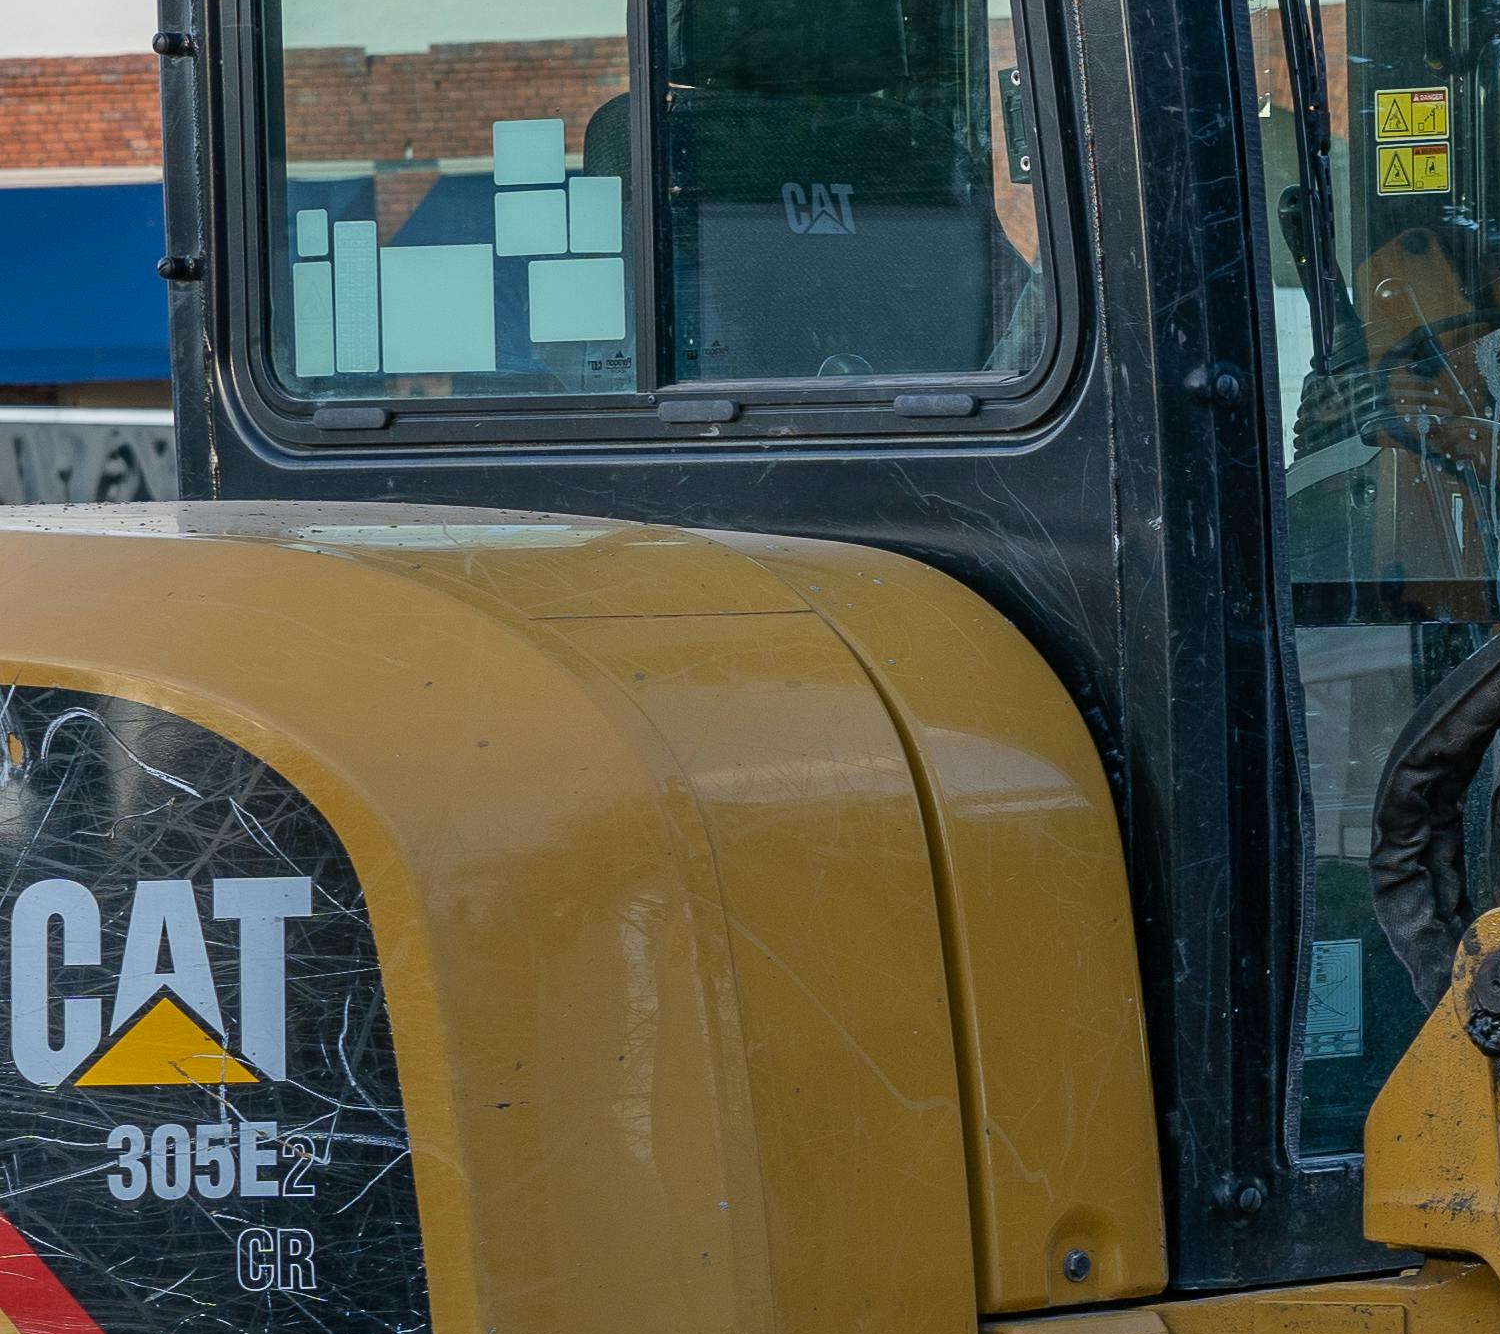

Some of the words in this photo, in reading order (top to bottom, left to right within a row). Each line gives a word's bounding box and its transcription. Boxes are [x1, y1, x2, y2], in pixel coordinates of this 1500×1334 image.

[782, 182, 856, 235] CAT
[10, 876, 312, 1087] CAT
[107, 1120, 317, 1202] 305E2
[236, 1227, 316, 1292] CR
